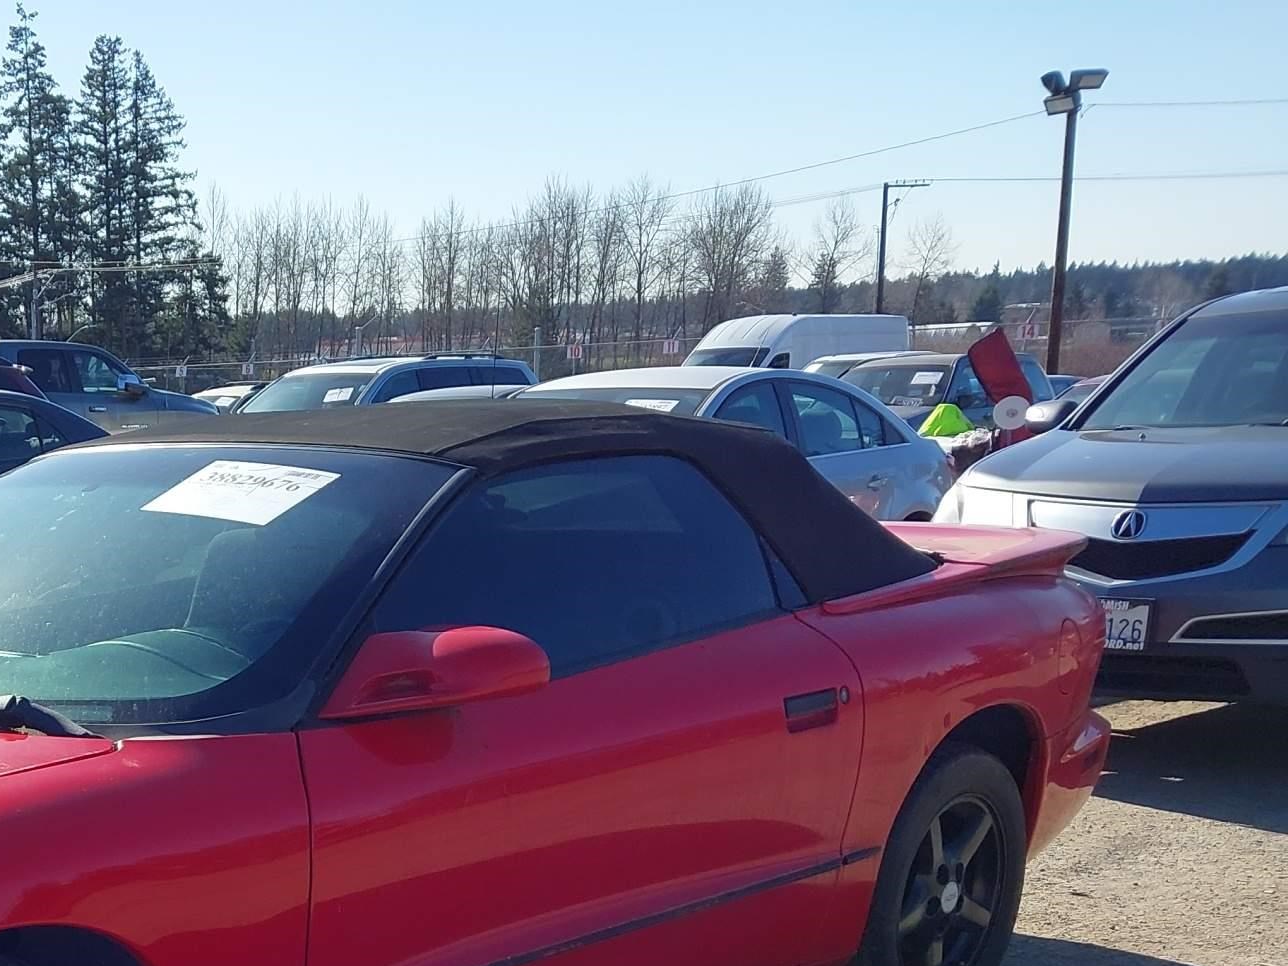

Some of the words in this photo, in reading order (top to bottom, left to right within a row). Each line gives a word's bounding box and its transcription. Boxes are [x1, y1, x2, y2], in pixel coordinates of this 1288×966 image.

[570, 345, 581, 358] 10
[200, 471, 301, 492] 38829676
[1107, 618, 1143, 641] 126
